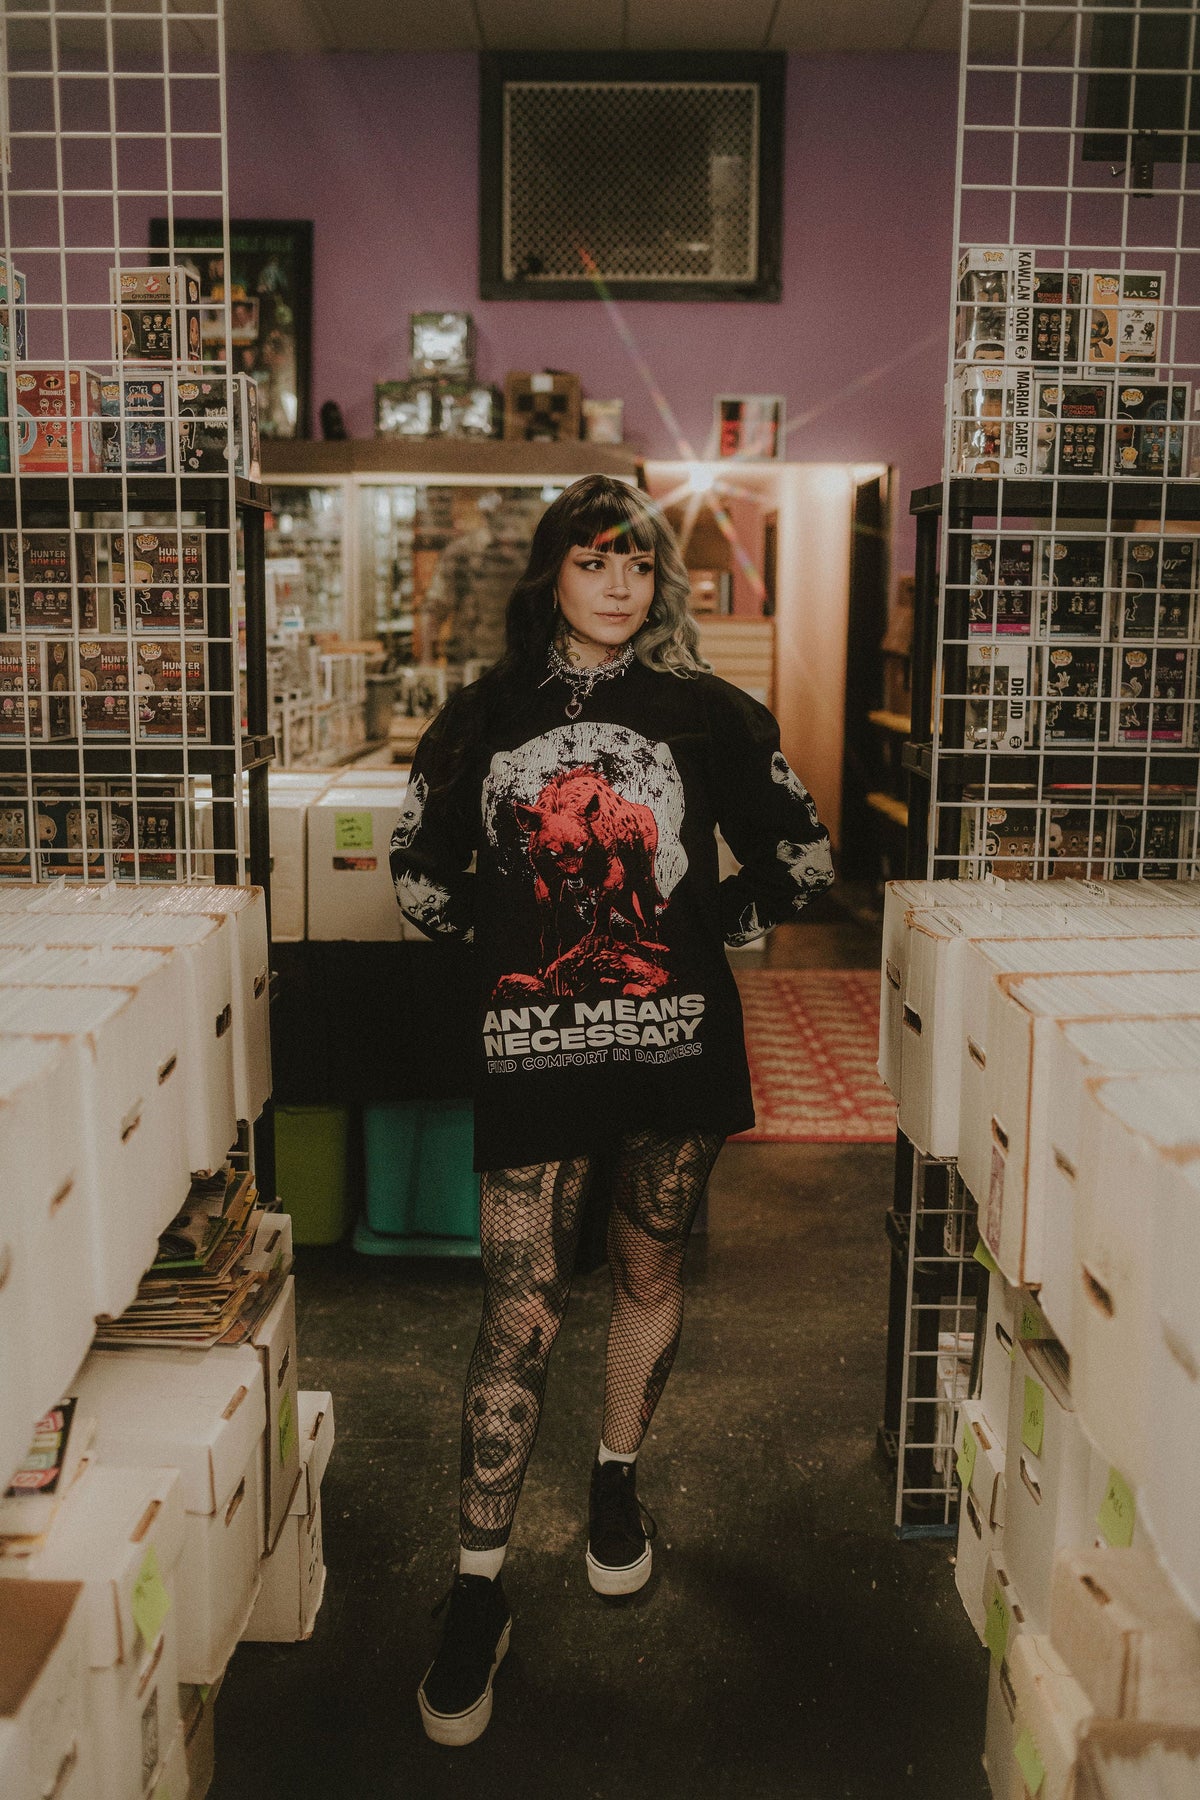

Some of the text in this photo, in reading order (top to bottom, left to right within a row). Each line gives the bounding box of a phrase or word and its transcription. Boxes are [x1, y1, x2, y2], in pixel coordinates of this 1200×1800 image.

[1018, 252, 1031, 300] KAWLAN
[1015, 371, 1030, 473] MARIAH CAREY 85
[30, 549, 66, 558] HUNTER
[483, 994, 705, 1033] ANY MEANS
[483, 1018, 703, 1057] NECESSARY
[487, 1042, 703, 1074] FIND COMFORT IN DARKNESS
